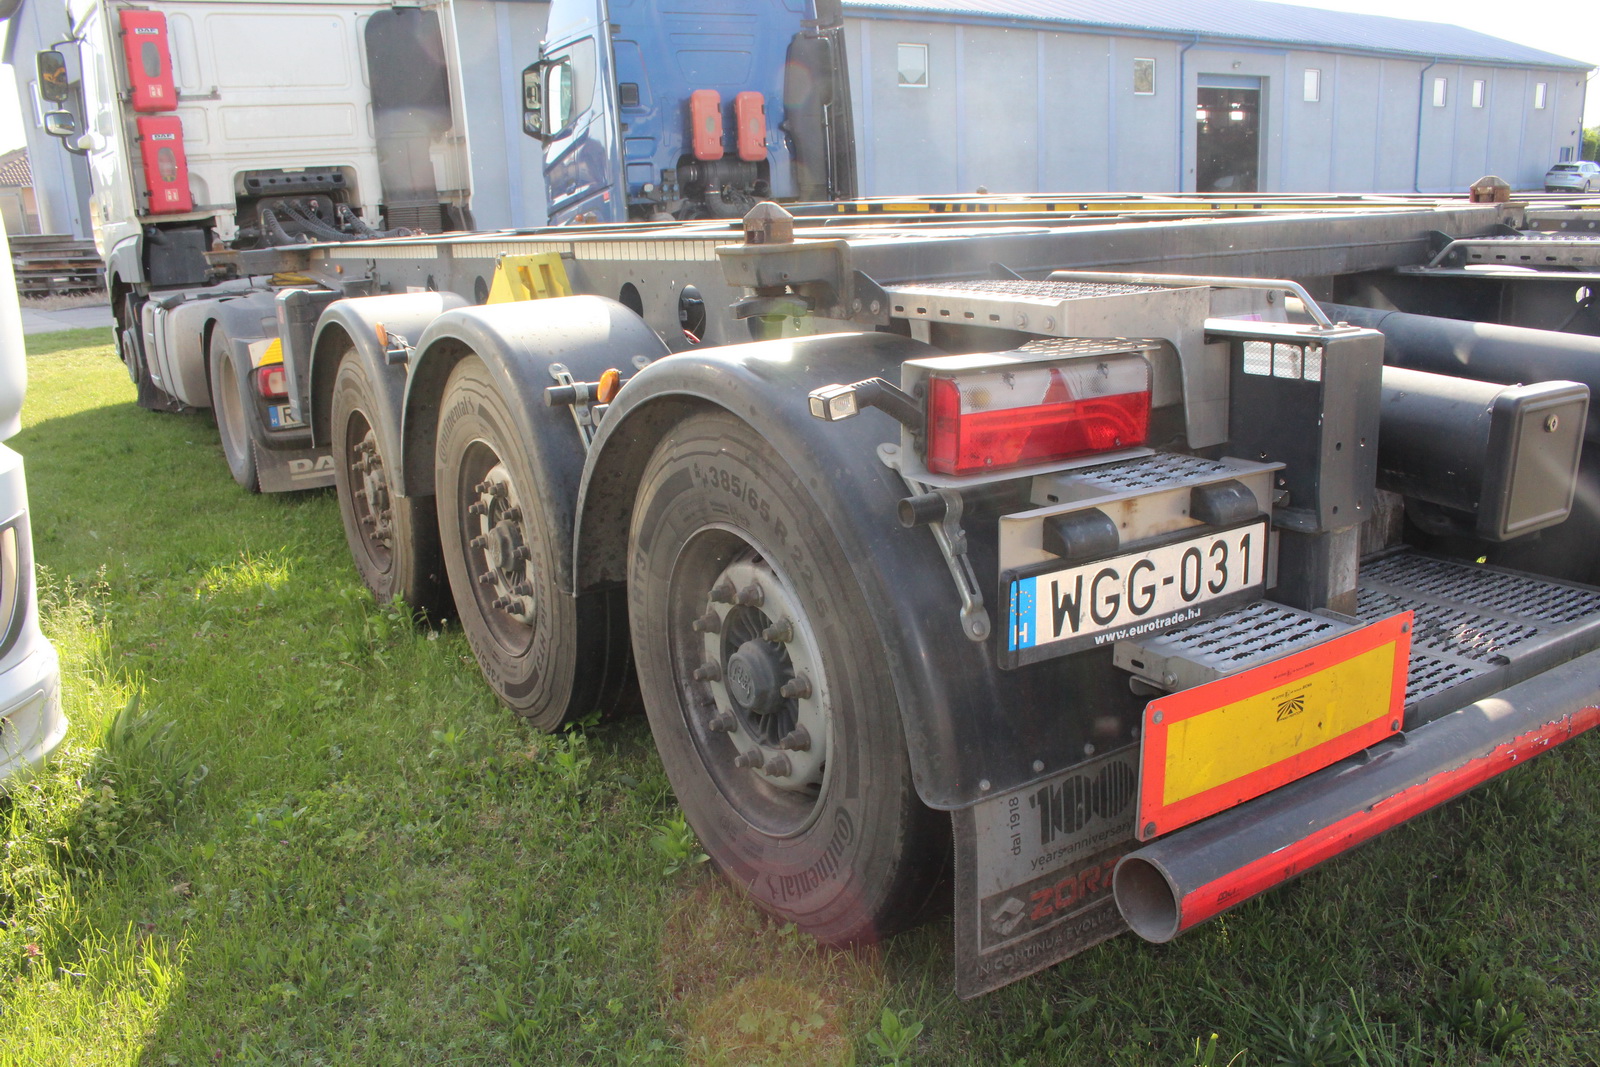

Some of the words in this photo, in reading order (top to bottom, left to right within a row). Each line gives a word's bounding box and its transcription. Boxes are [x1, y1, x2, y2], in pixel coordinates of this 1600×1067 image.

[438, 396, 470, 464] Continental
[288, 455, 335, 474] DA
[709, 466, 771, 522] 385/65
[774, 516, 789, 545] R
[1050, 532, 1251, 638] WGG-031
[1013, 623, 1028, 646] H
[1094, 608, 1202, 645] www.eurotrade.hu
[1008, 796, 1020, 830] 1918
[779, 806, 855, 902] Continental
[1011, 833, 1021, 855] dal
[1030, 848, 1064, 870] years
[1067, 820, 1133, 854] anniversary
[1029, 856, 1121, 921] ZORZ
[994, 933, 1063, 970] CONTINUA
[1066, 906, 1116, 941] EVOLUZ
